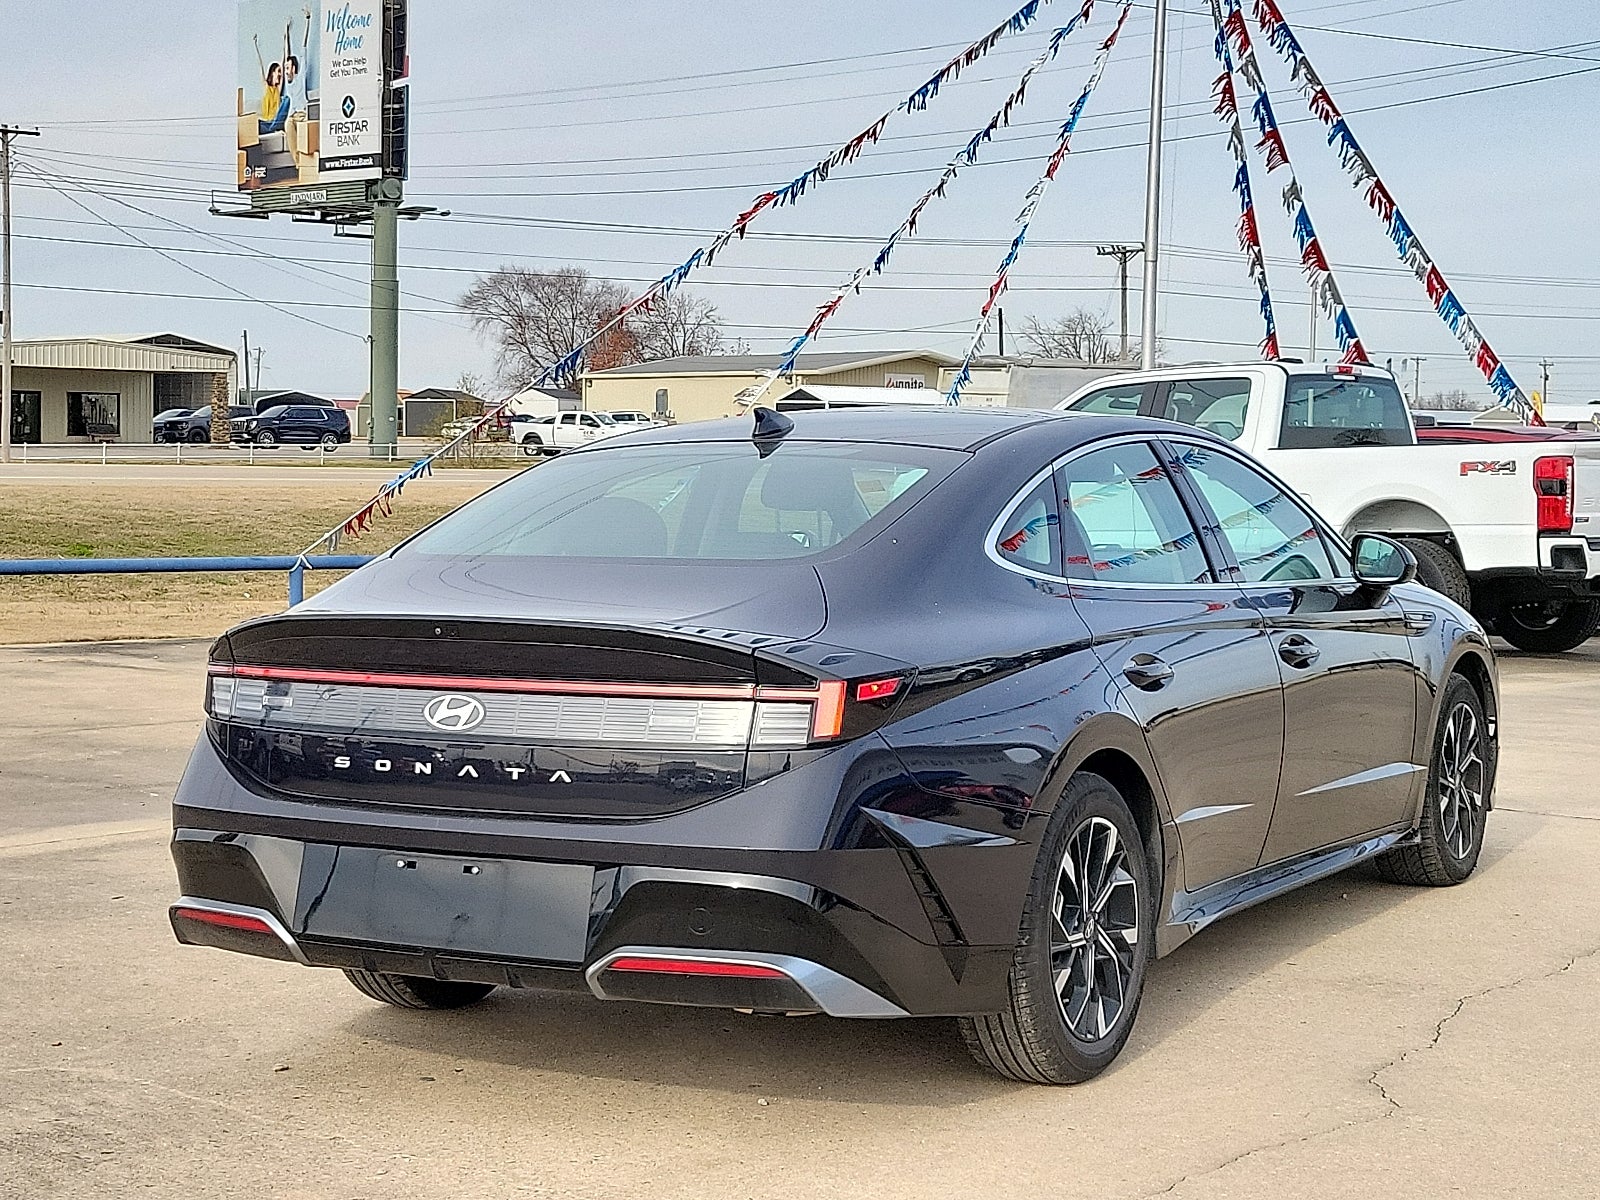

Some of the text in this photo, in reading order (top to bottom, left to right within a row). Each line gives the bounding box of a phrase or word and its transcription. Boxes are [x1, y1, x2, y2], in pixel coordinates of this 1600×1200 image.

[326, 2, 372, 33] Welcome
[335, 30, 363, 55] Home
[342, 58, 353, 67] Can
[354, 56, 368, 66] Help
[330, 69, 340, 78] Get
[341, 68, 351, 76] You
[329, 120, 369, 135] FIRSTAR
[337, 135, 360, 147] BANK
[291, 192, 325, 203] LANDMARK
[1460, 461, 1516, 476] FX4
[333, 756, 573, 784] SONATA
